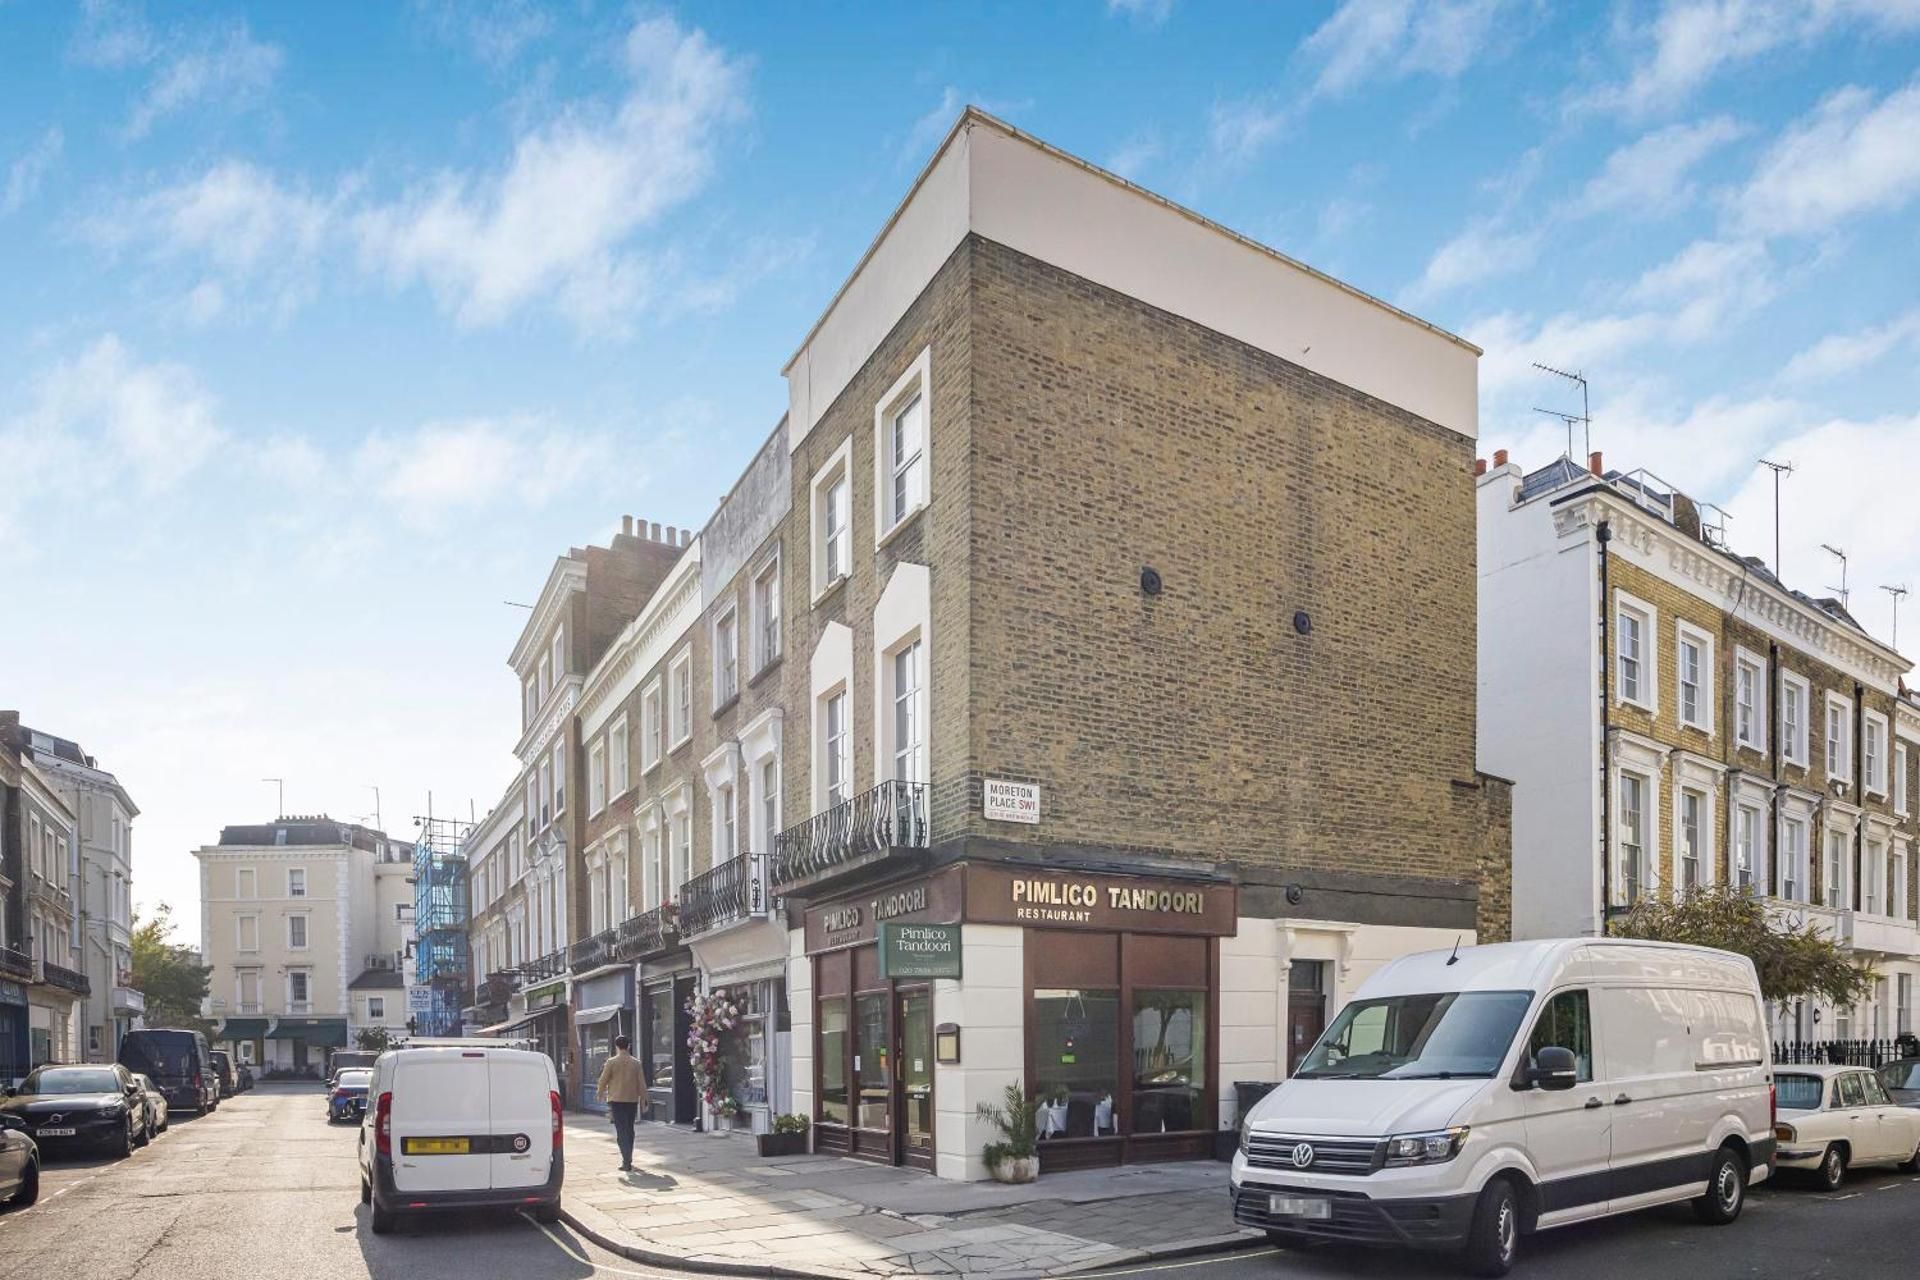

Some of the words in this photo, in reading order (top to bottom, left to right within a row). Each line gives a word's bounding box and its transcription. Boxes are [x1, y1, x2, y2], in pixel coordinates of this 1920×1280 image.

[990, 784, 1033, 798] MORETON
[990, 795, 1016, 808] PLACE
[1013, 879, 1097, 907] PIMLICO
[1108, 887, 1204, 914] TANDOORI
[823, 908, 859, 933] PIMLICO
[871, 887, 925, 920] TANDOORI
[1017, 907, 1091, 922] RESTAURANT
[901, 927, 947, 940] Pimlico
[896, 940, 951, 952] Tandoori
